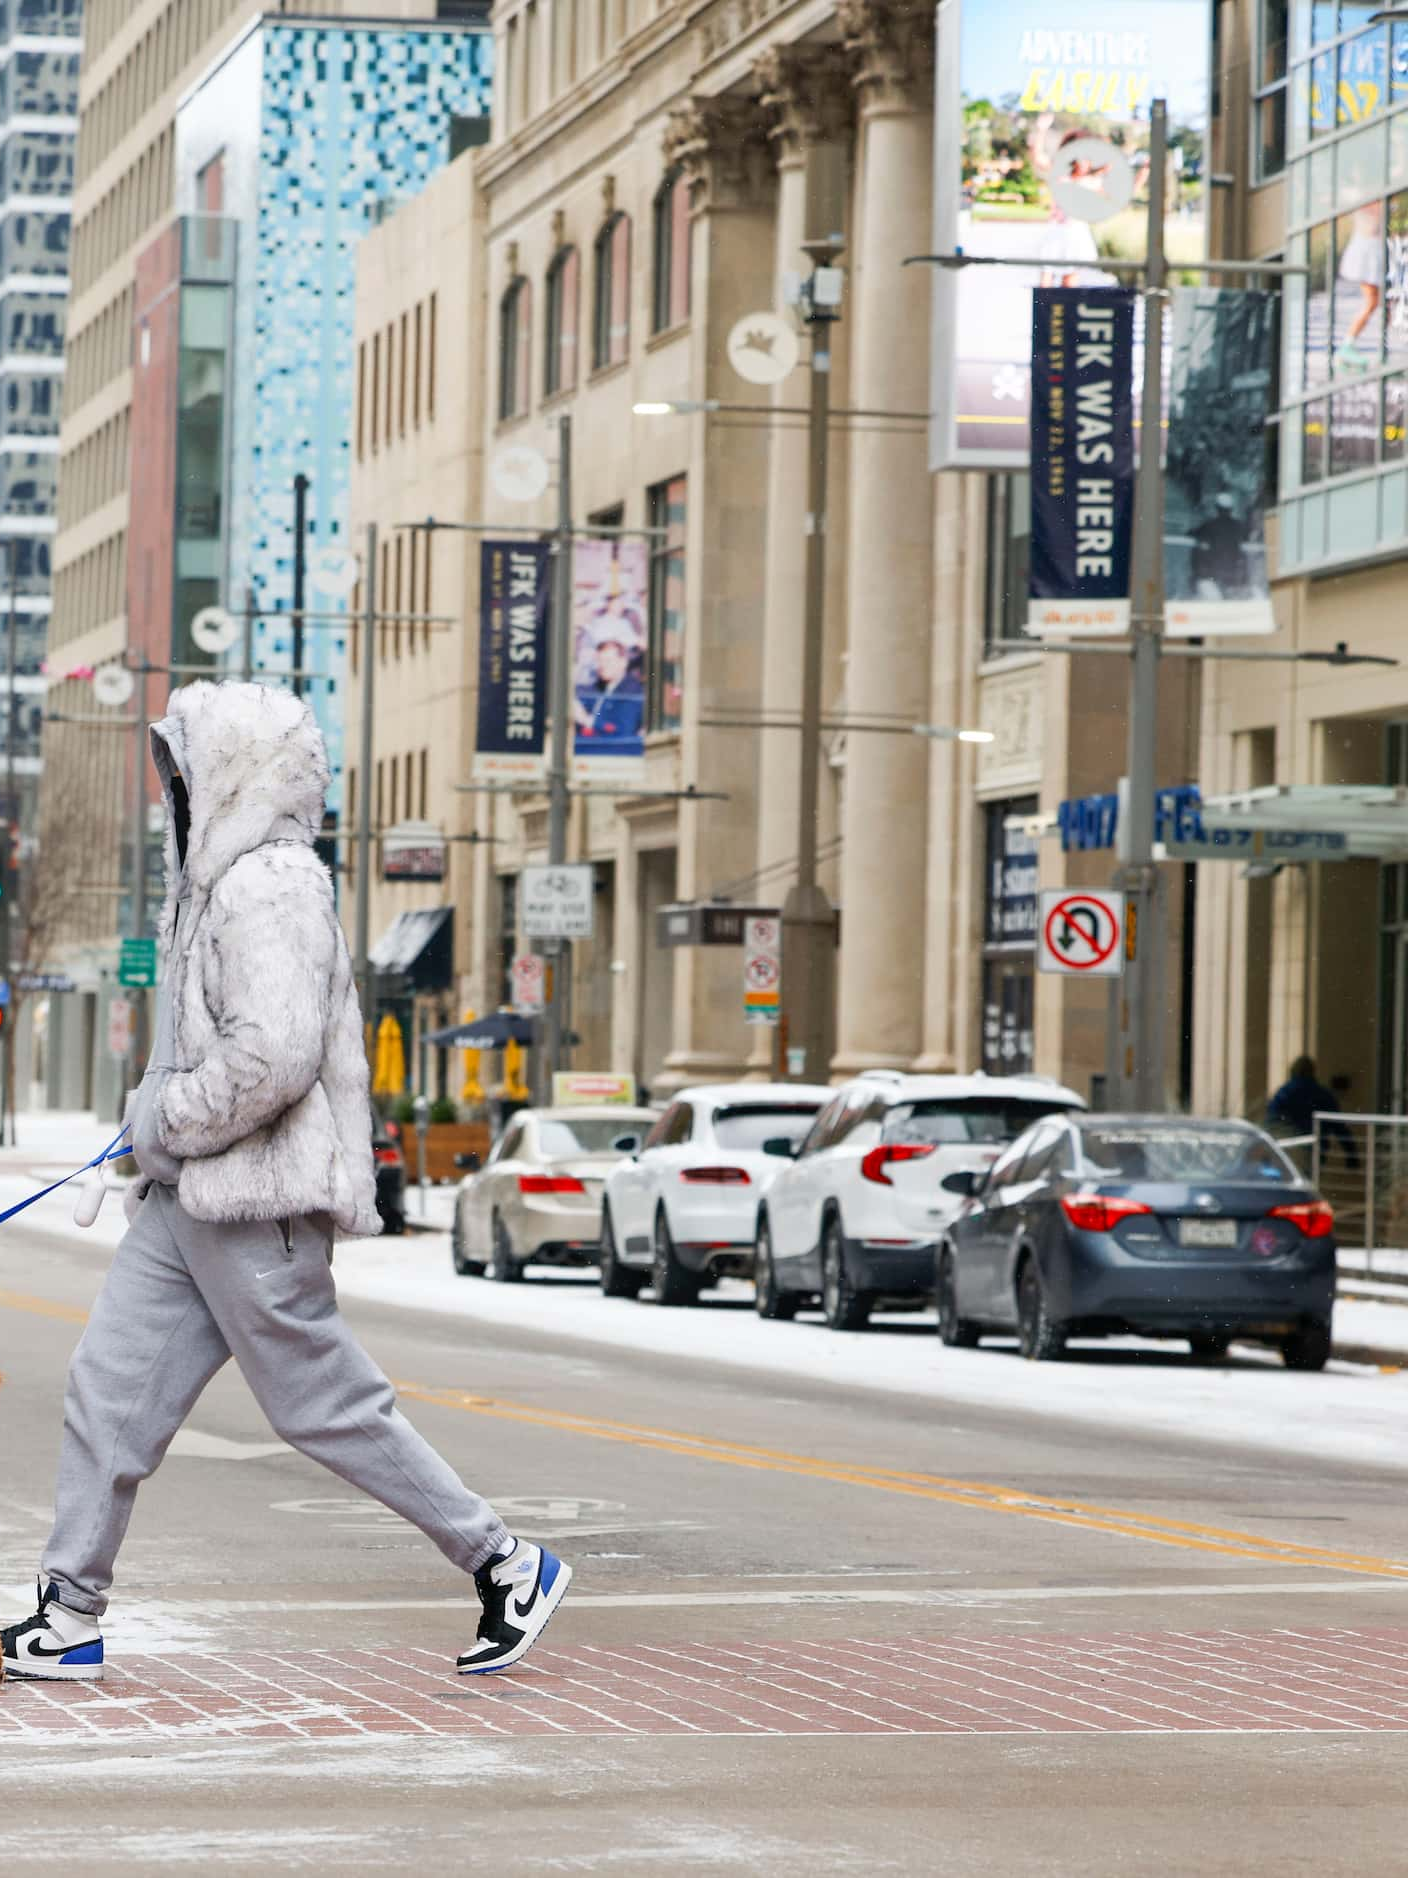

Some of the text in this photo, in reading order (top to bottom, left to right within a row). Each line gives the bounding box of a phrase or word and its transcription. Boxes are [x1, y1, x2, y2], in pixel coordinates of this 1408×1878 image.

[1019, 31, 1151, 66] ADVENTURE
[1020, 67, 1149, 113] EASILY
[1049, 303, 1065, 346] MAIN
[1049, 350, 1065, 371] ST
[1049, 386, 1065, 421] NOV
[1075, 303, 1114, 577] JFK WAS HERE
[509, 551, 537, 597] JFK
[508, 604, 537, 662] WAS
[506, 670, 535, 740] HERE
